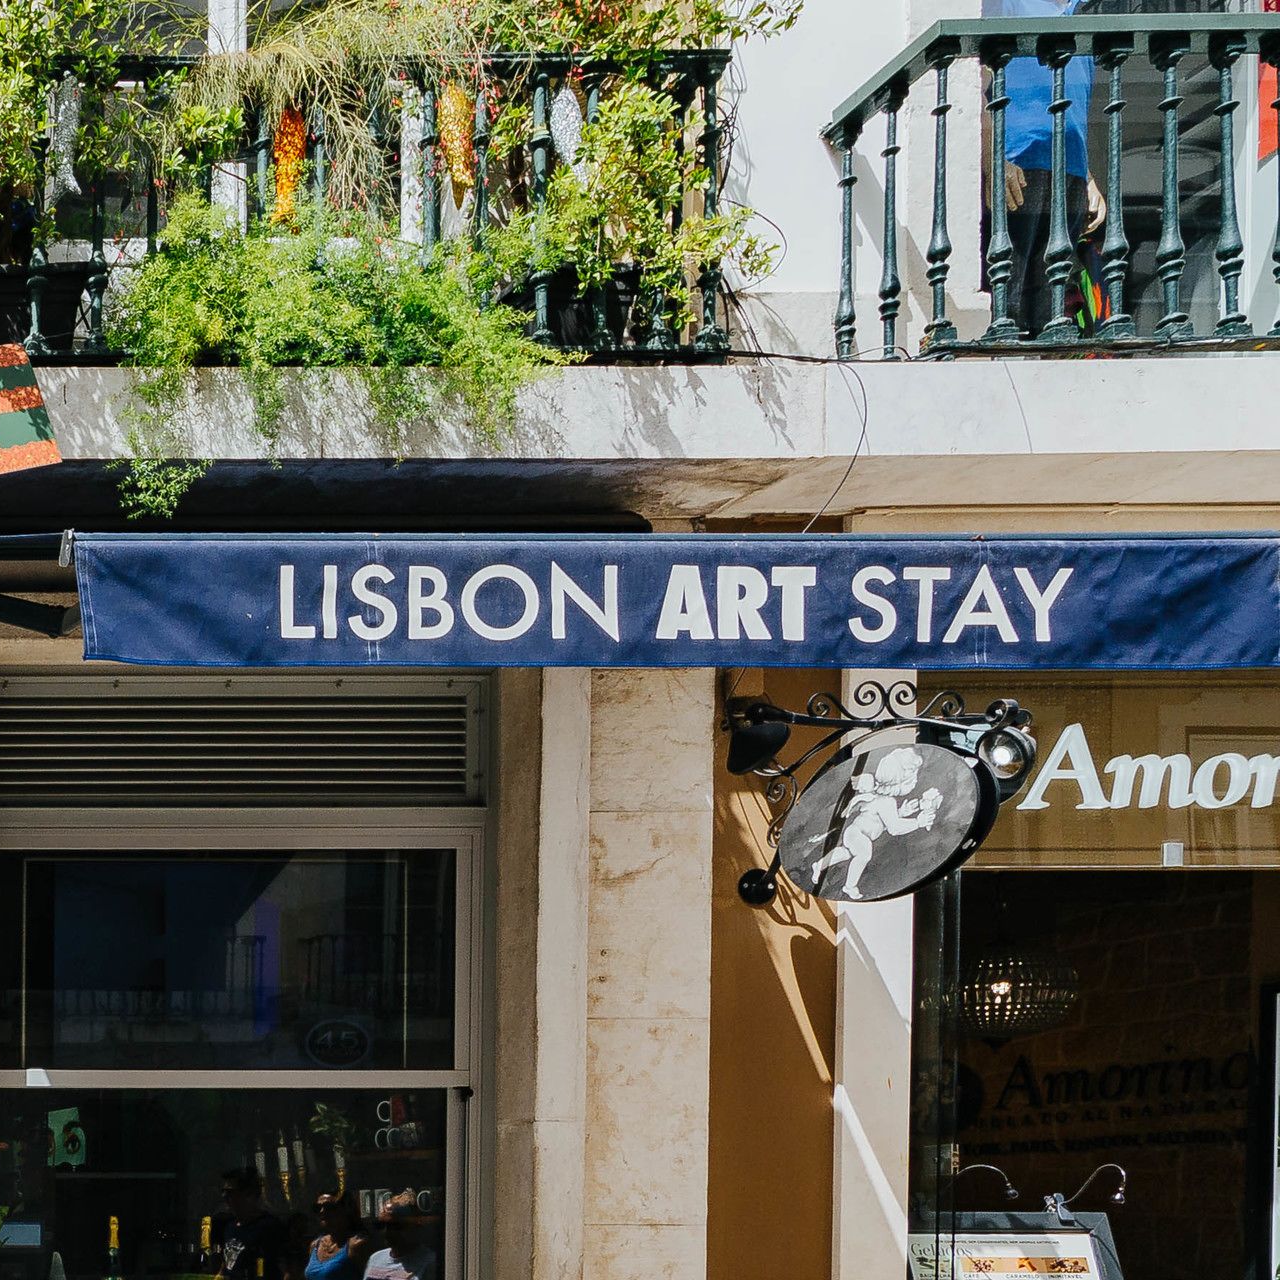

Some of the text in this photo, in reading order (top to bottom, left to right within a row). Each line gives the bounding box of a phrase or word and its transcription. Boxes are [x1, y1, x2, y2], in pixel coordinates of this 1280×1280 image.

[280, 560, 1075, 644] LISBON ART STAY
